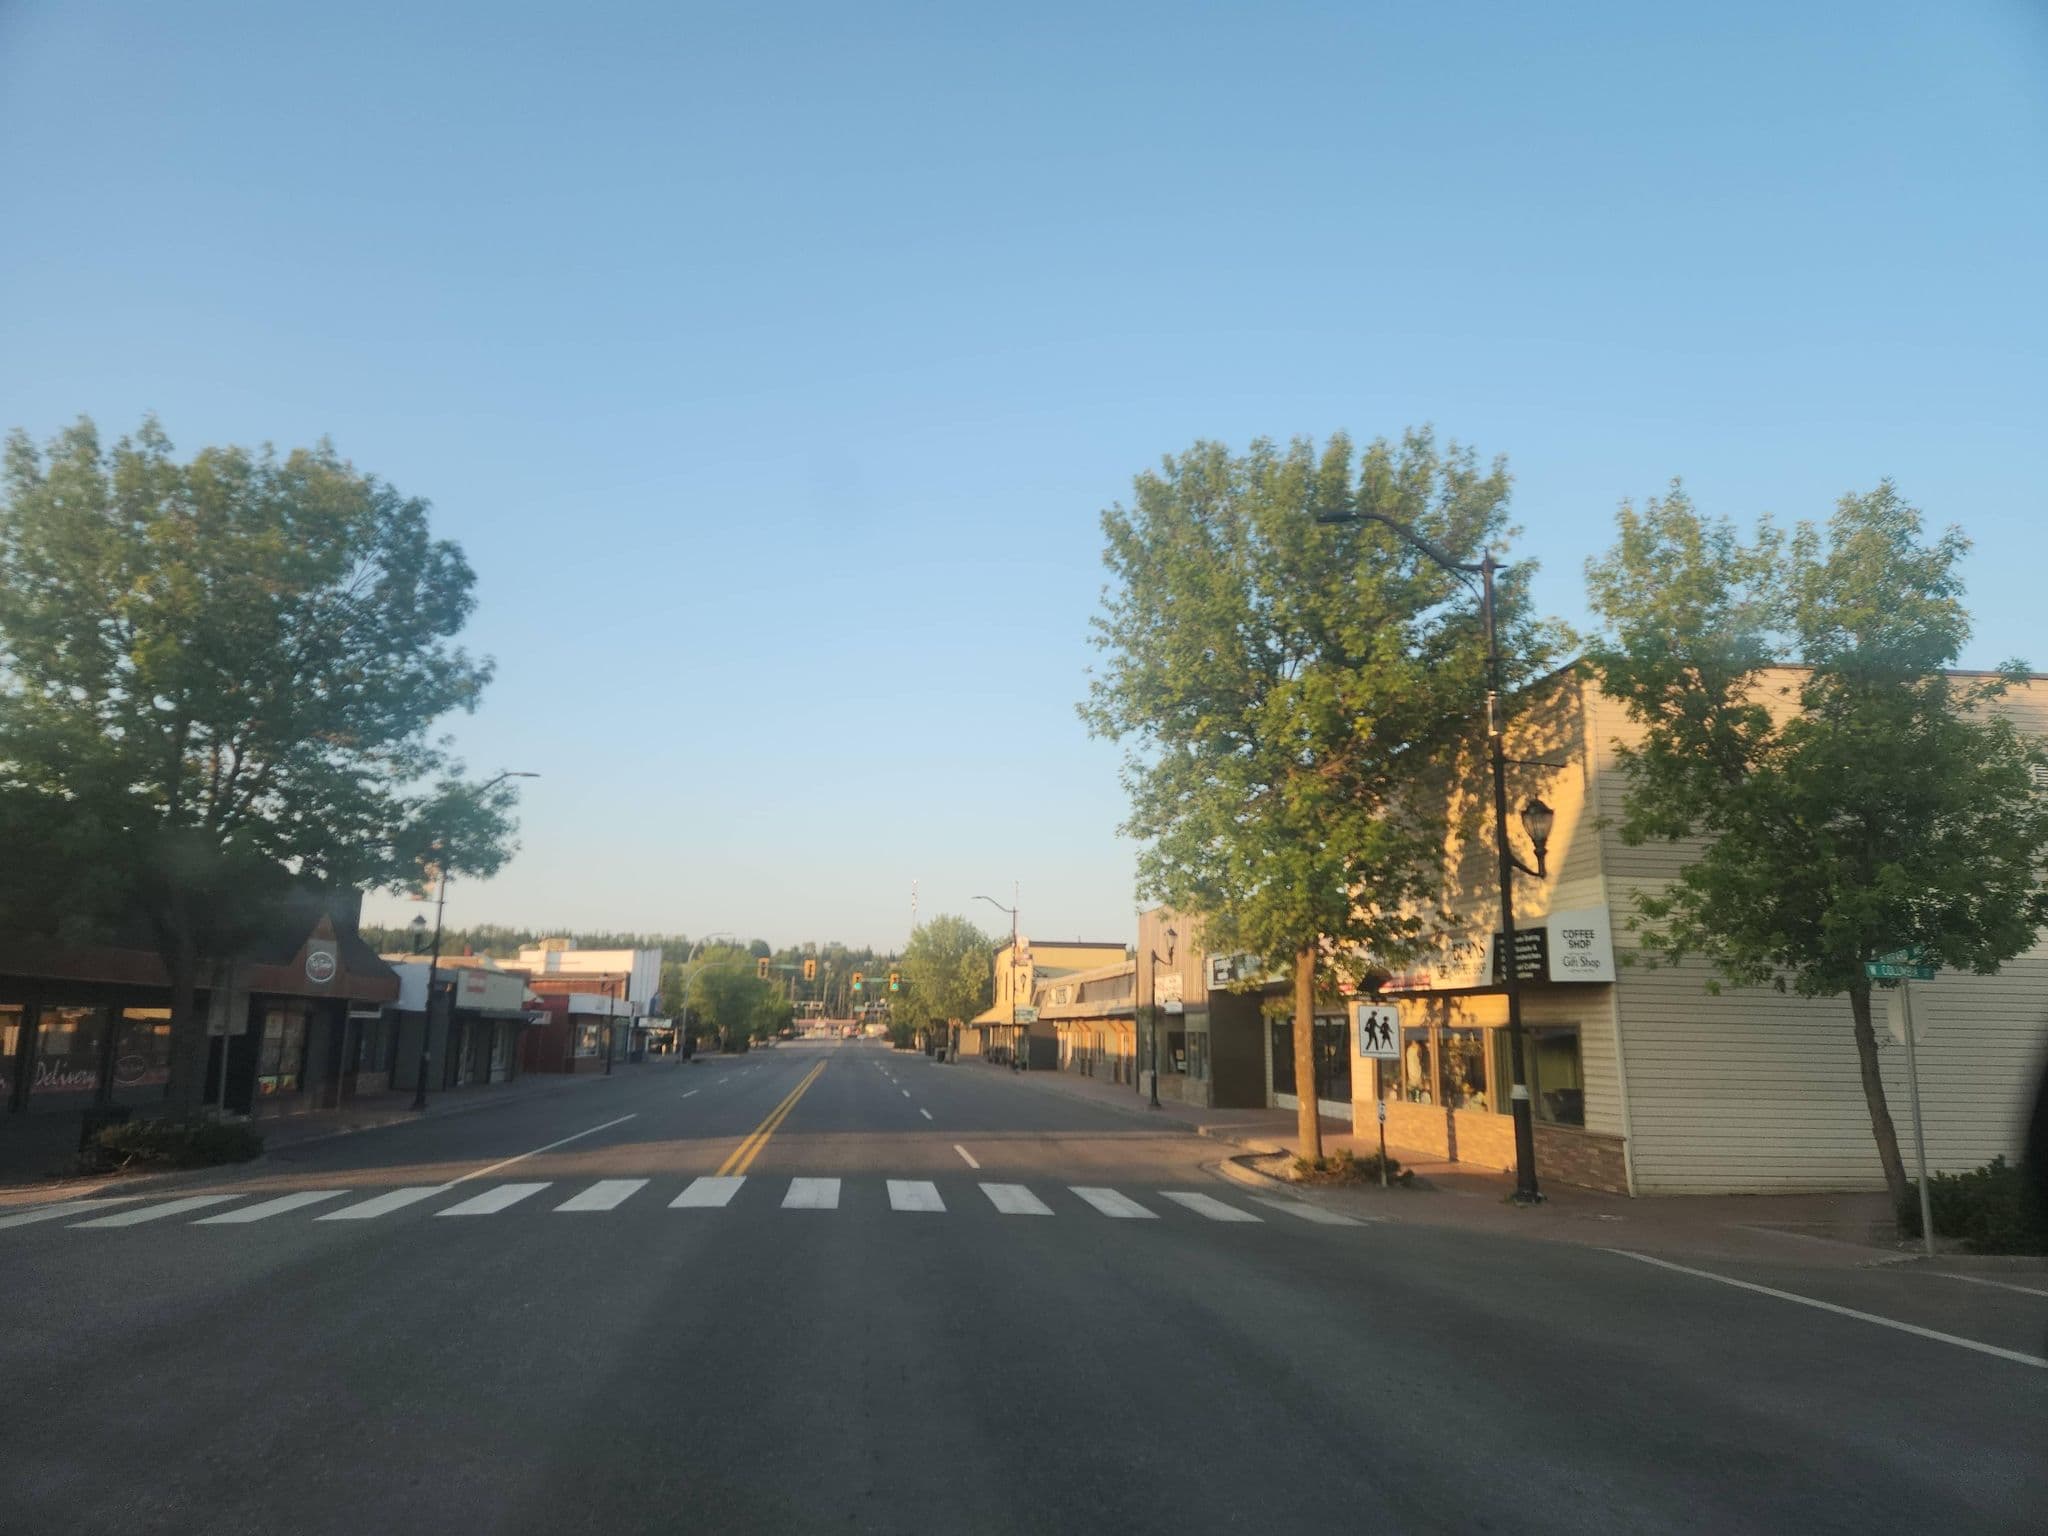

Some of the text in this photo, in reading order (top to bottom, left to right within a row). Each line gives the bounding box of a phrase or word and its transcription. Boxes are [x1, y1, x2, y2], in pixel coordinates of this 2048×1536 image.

[1562, 929, 1596, 939] COFFEE
[1568, 939, 1591, 949] SHOP
[1562, 955, 1600, 969] Gift Shop
[35, 1058, 96, 1088] Delivery
